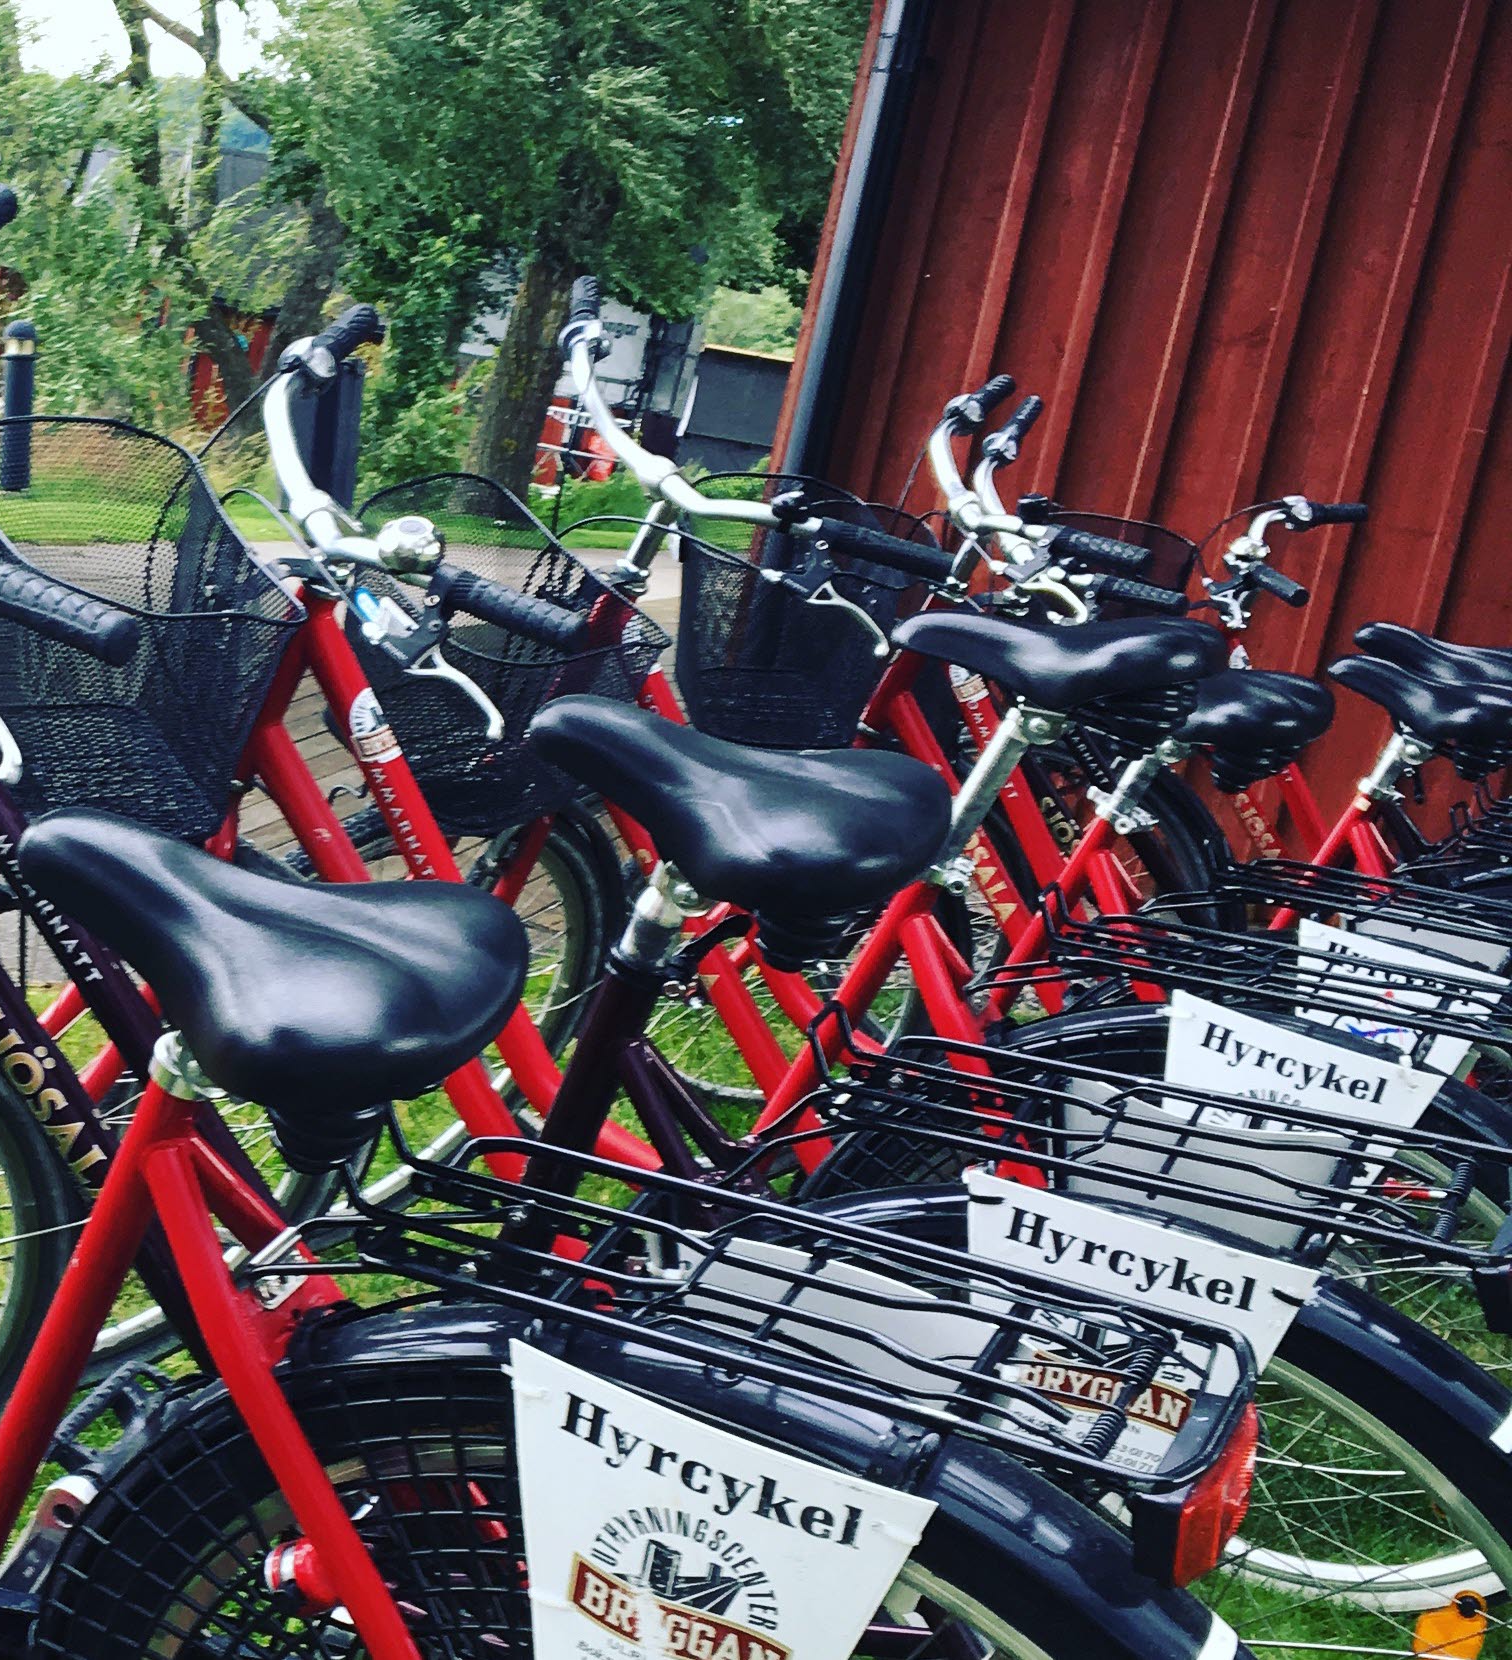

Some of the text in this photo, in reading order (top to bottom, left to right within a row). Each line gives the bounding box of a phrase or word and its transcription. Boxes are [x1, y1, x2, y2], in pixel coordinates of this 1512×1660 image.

[1200, 1021, 1388, 1104] Hyrcykel
[1005, 1206, 1256, 1312] Hyrcykel
[558, 1391, 865, 1550] Hyrcykel
[579, 1571, 781, 1660] BRGGA
[590, 1506, 780, 1631] UTHYRNINGSCENTER
